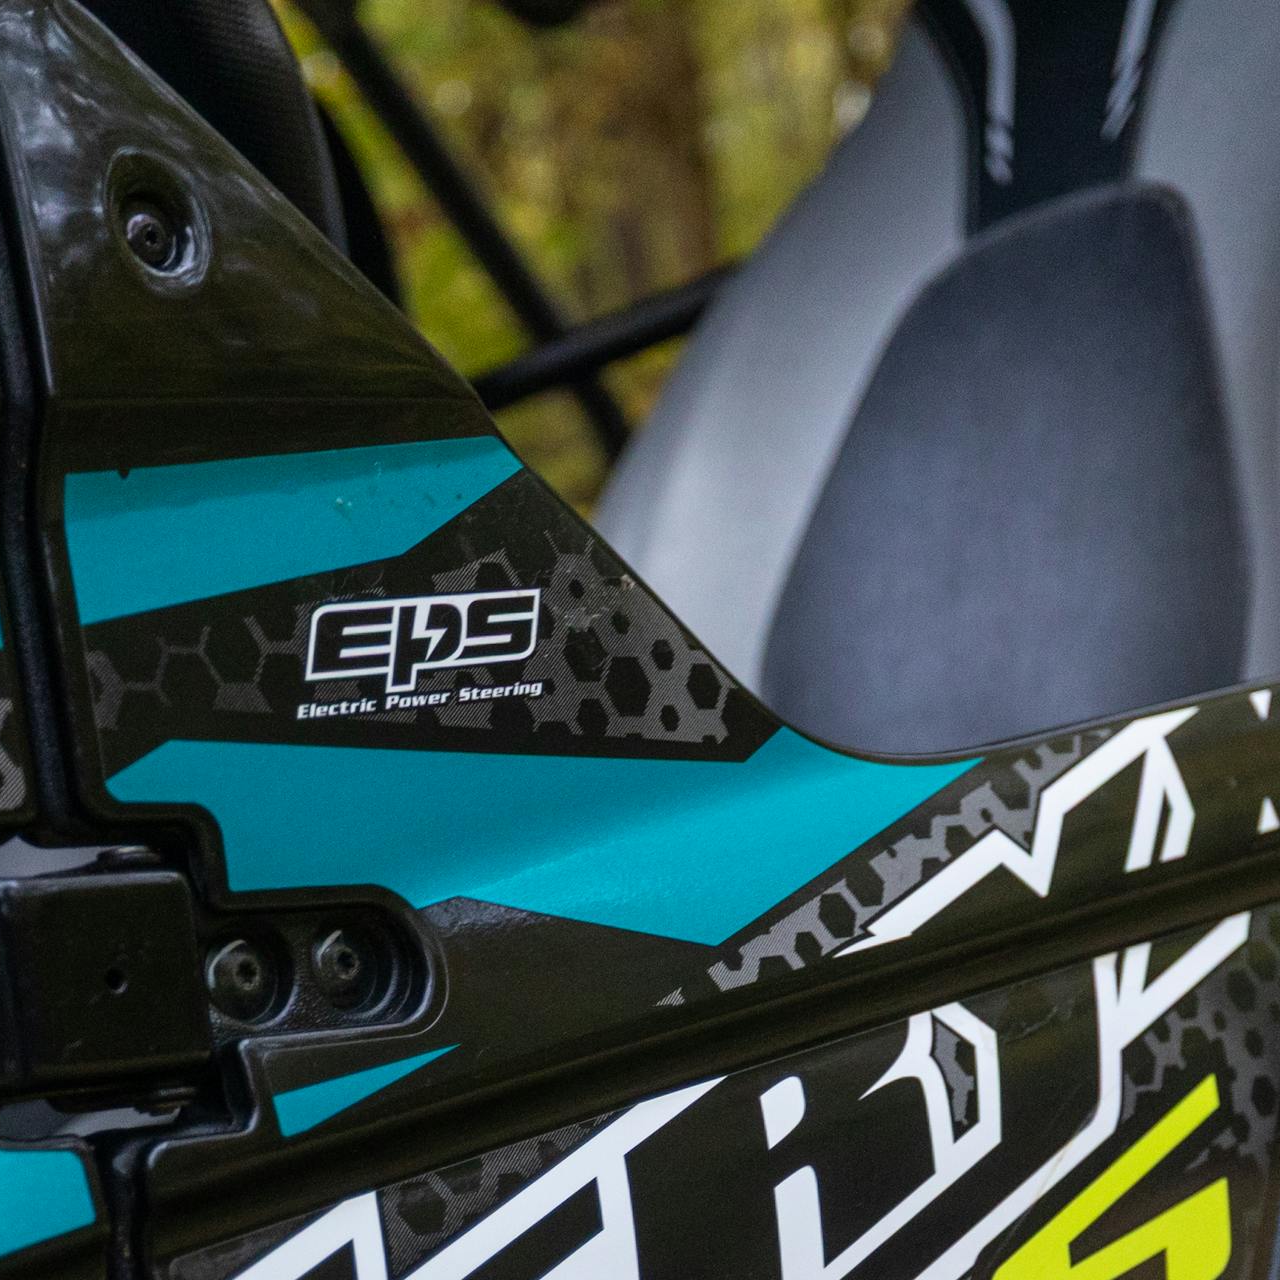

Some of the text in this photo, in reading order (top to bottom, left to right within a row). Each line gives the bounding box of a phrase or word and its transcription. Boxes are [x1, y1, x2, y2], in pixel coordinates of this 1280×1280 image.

[305, 588, 541, 693] EPS
[296, 681, 543, 720] Electric Power Steering
